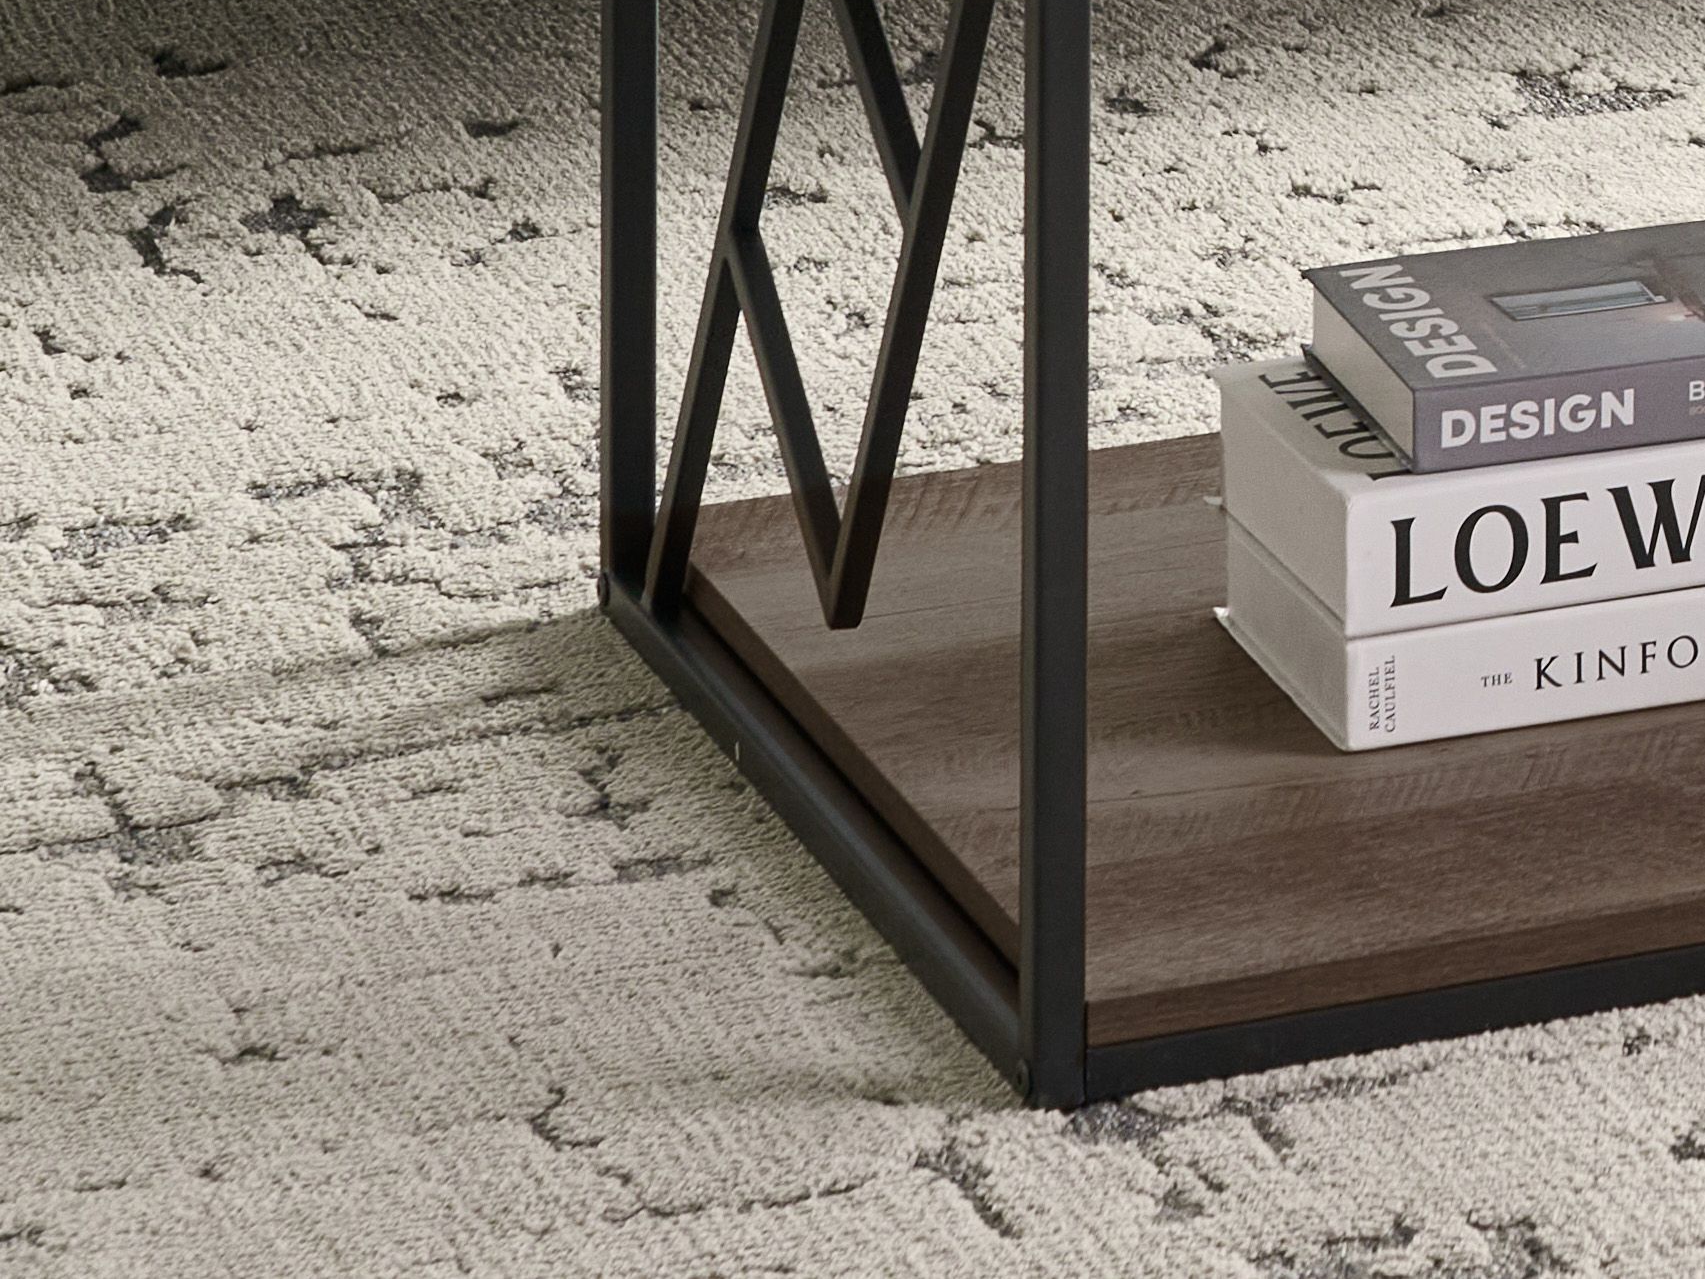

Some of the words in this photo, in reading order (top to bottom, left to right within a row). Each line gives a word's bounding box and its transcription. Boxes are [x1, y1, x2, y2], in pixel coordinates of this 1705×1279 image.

[1339, 264, 1498, 379] DESIGN
[1441, 388, 1635, 449] DESIGN
[1368, 667, 1380, 731] RACHEL
[1384, 655, 1396, 733] CAULFIEL
[1481, 672, 1513, 688] THE
